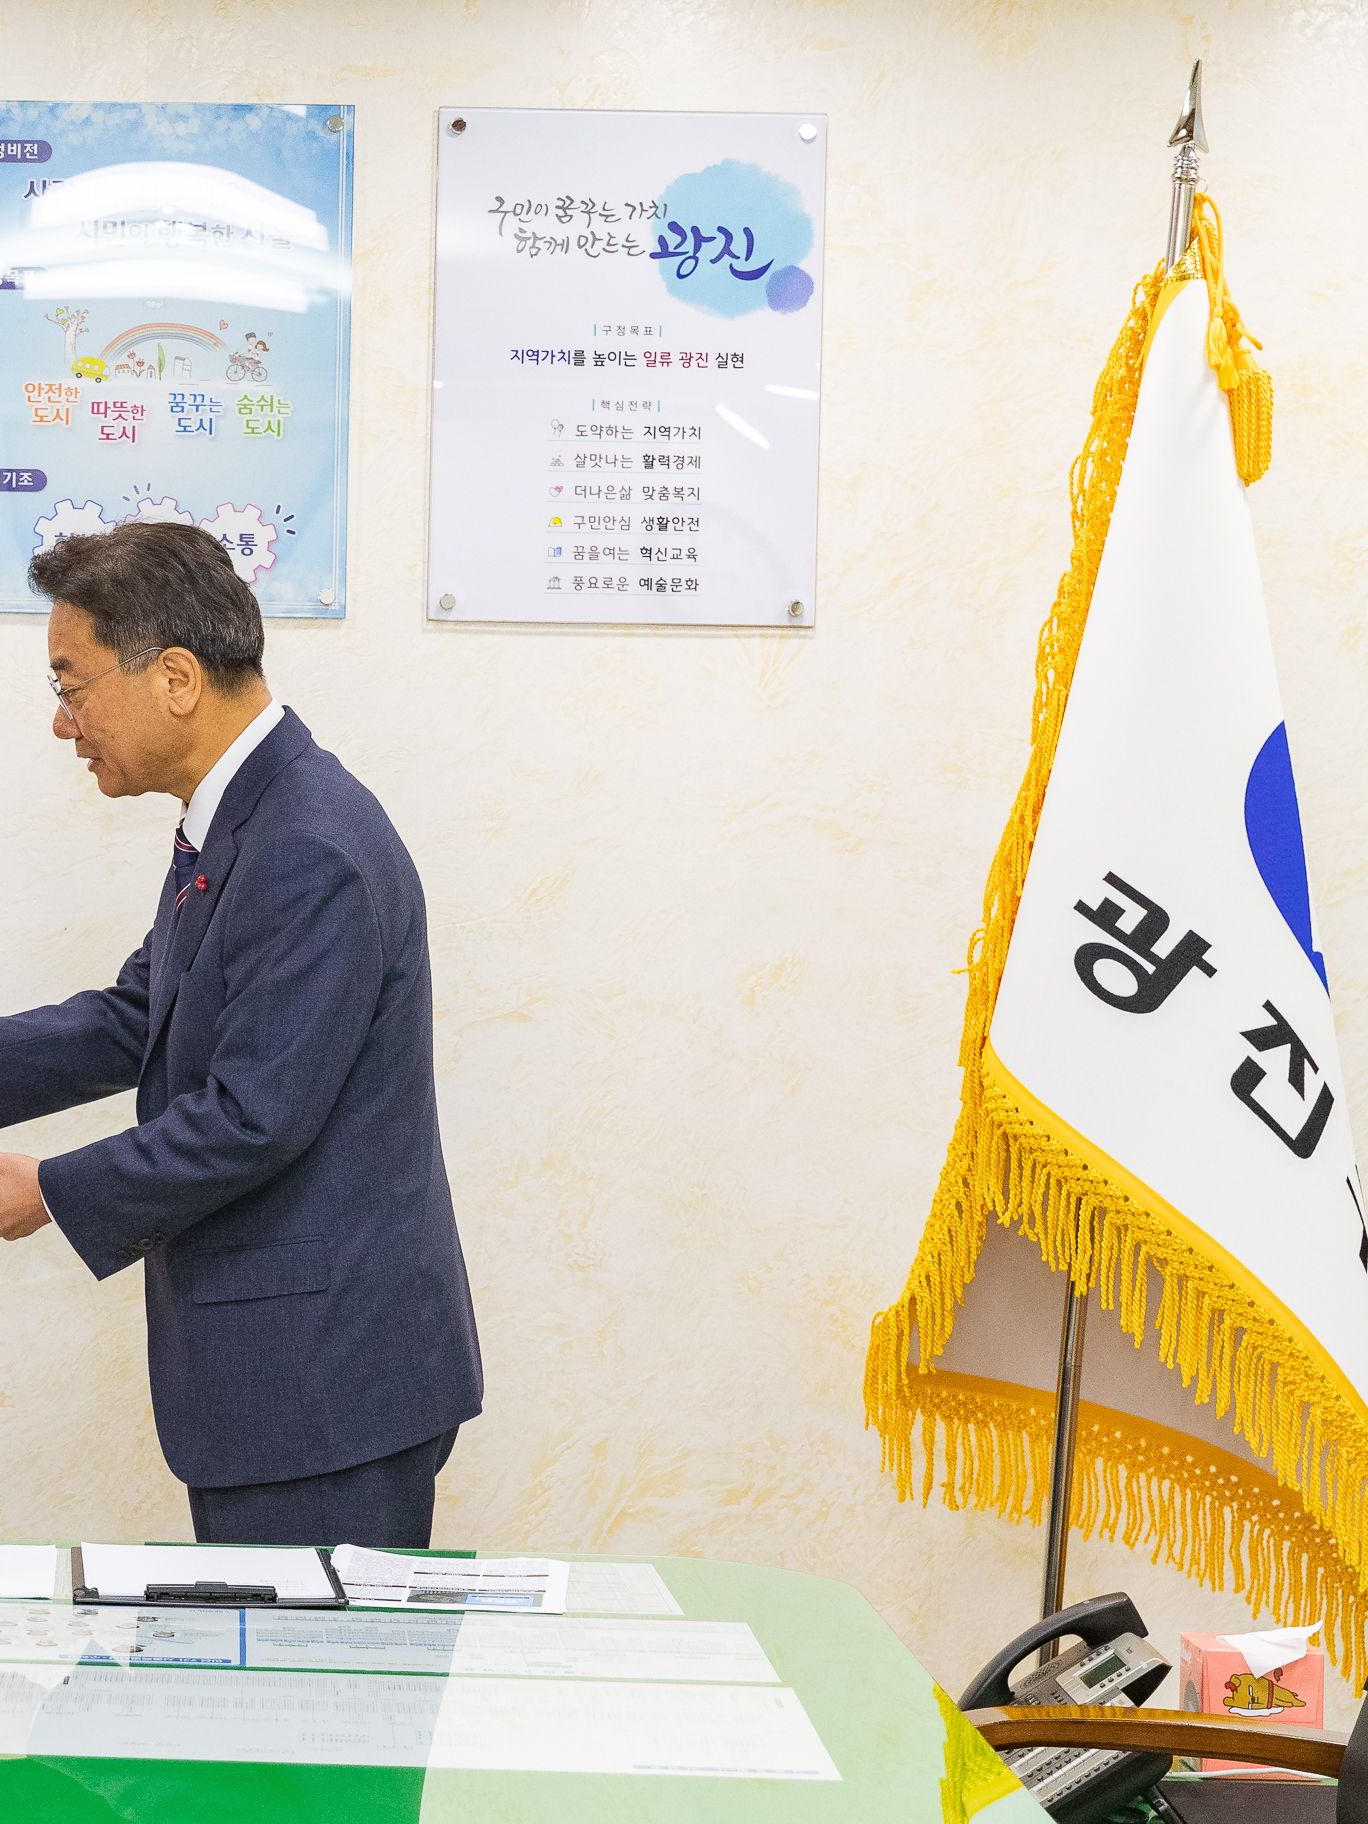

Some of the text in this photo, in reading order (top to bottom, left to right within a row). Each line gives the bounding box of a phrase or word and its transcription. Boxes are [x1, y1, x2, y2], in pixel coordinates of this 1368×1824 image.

[487, 194, 668, 237] 구민이 꿈꾸는 가치
[513, 220, 776, 282] 함께 만드는 광진
[601, 323, 654, 337] 구정목표
[509, 348, 745, 369] 지역가치를 높이는 일류 광진 실현
[23, 381, 80, 404] 안전한
[167, 391, 223, 413] 꿈꾸는
[89, 400, 146, 421] 따뜻한
[235, 393, 292, 416] 숨쉬는
[600, 399, 652, 411] 핵심전략
[31, 406, 70, 426] 도시
[174, 416, 214, 435] 도시
[97, 424, 137, 443] 도시
[242, 418, 282, 437] 도시
[574, 423, 702, 440] 도약하는 지역가치
[573, 452, 701, 470] 살맛나는 활력경제
[573, 484, 700, 501] 더나은삶 맞춤복지
[572, 514, 700, 532] 구민안심 생활안전
[572, 544, 698, 562] 꿈을여는 혁신교육
[571, 575, 699, 593] 풍요로운 예술문화
